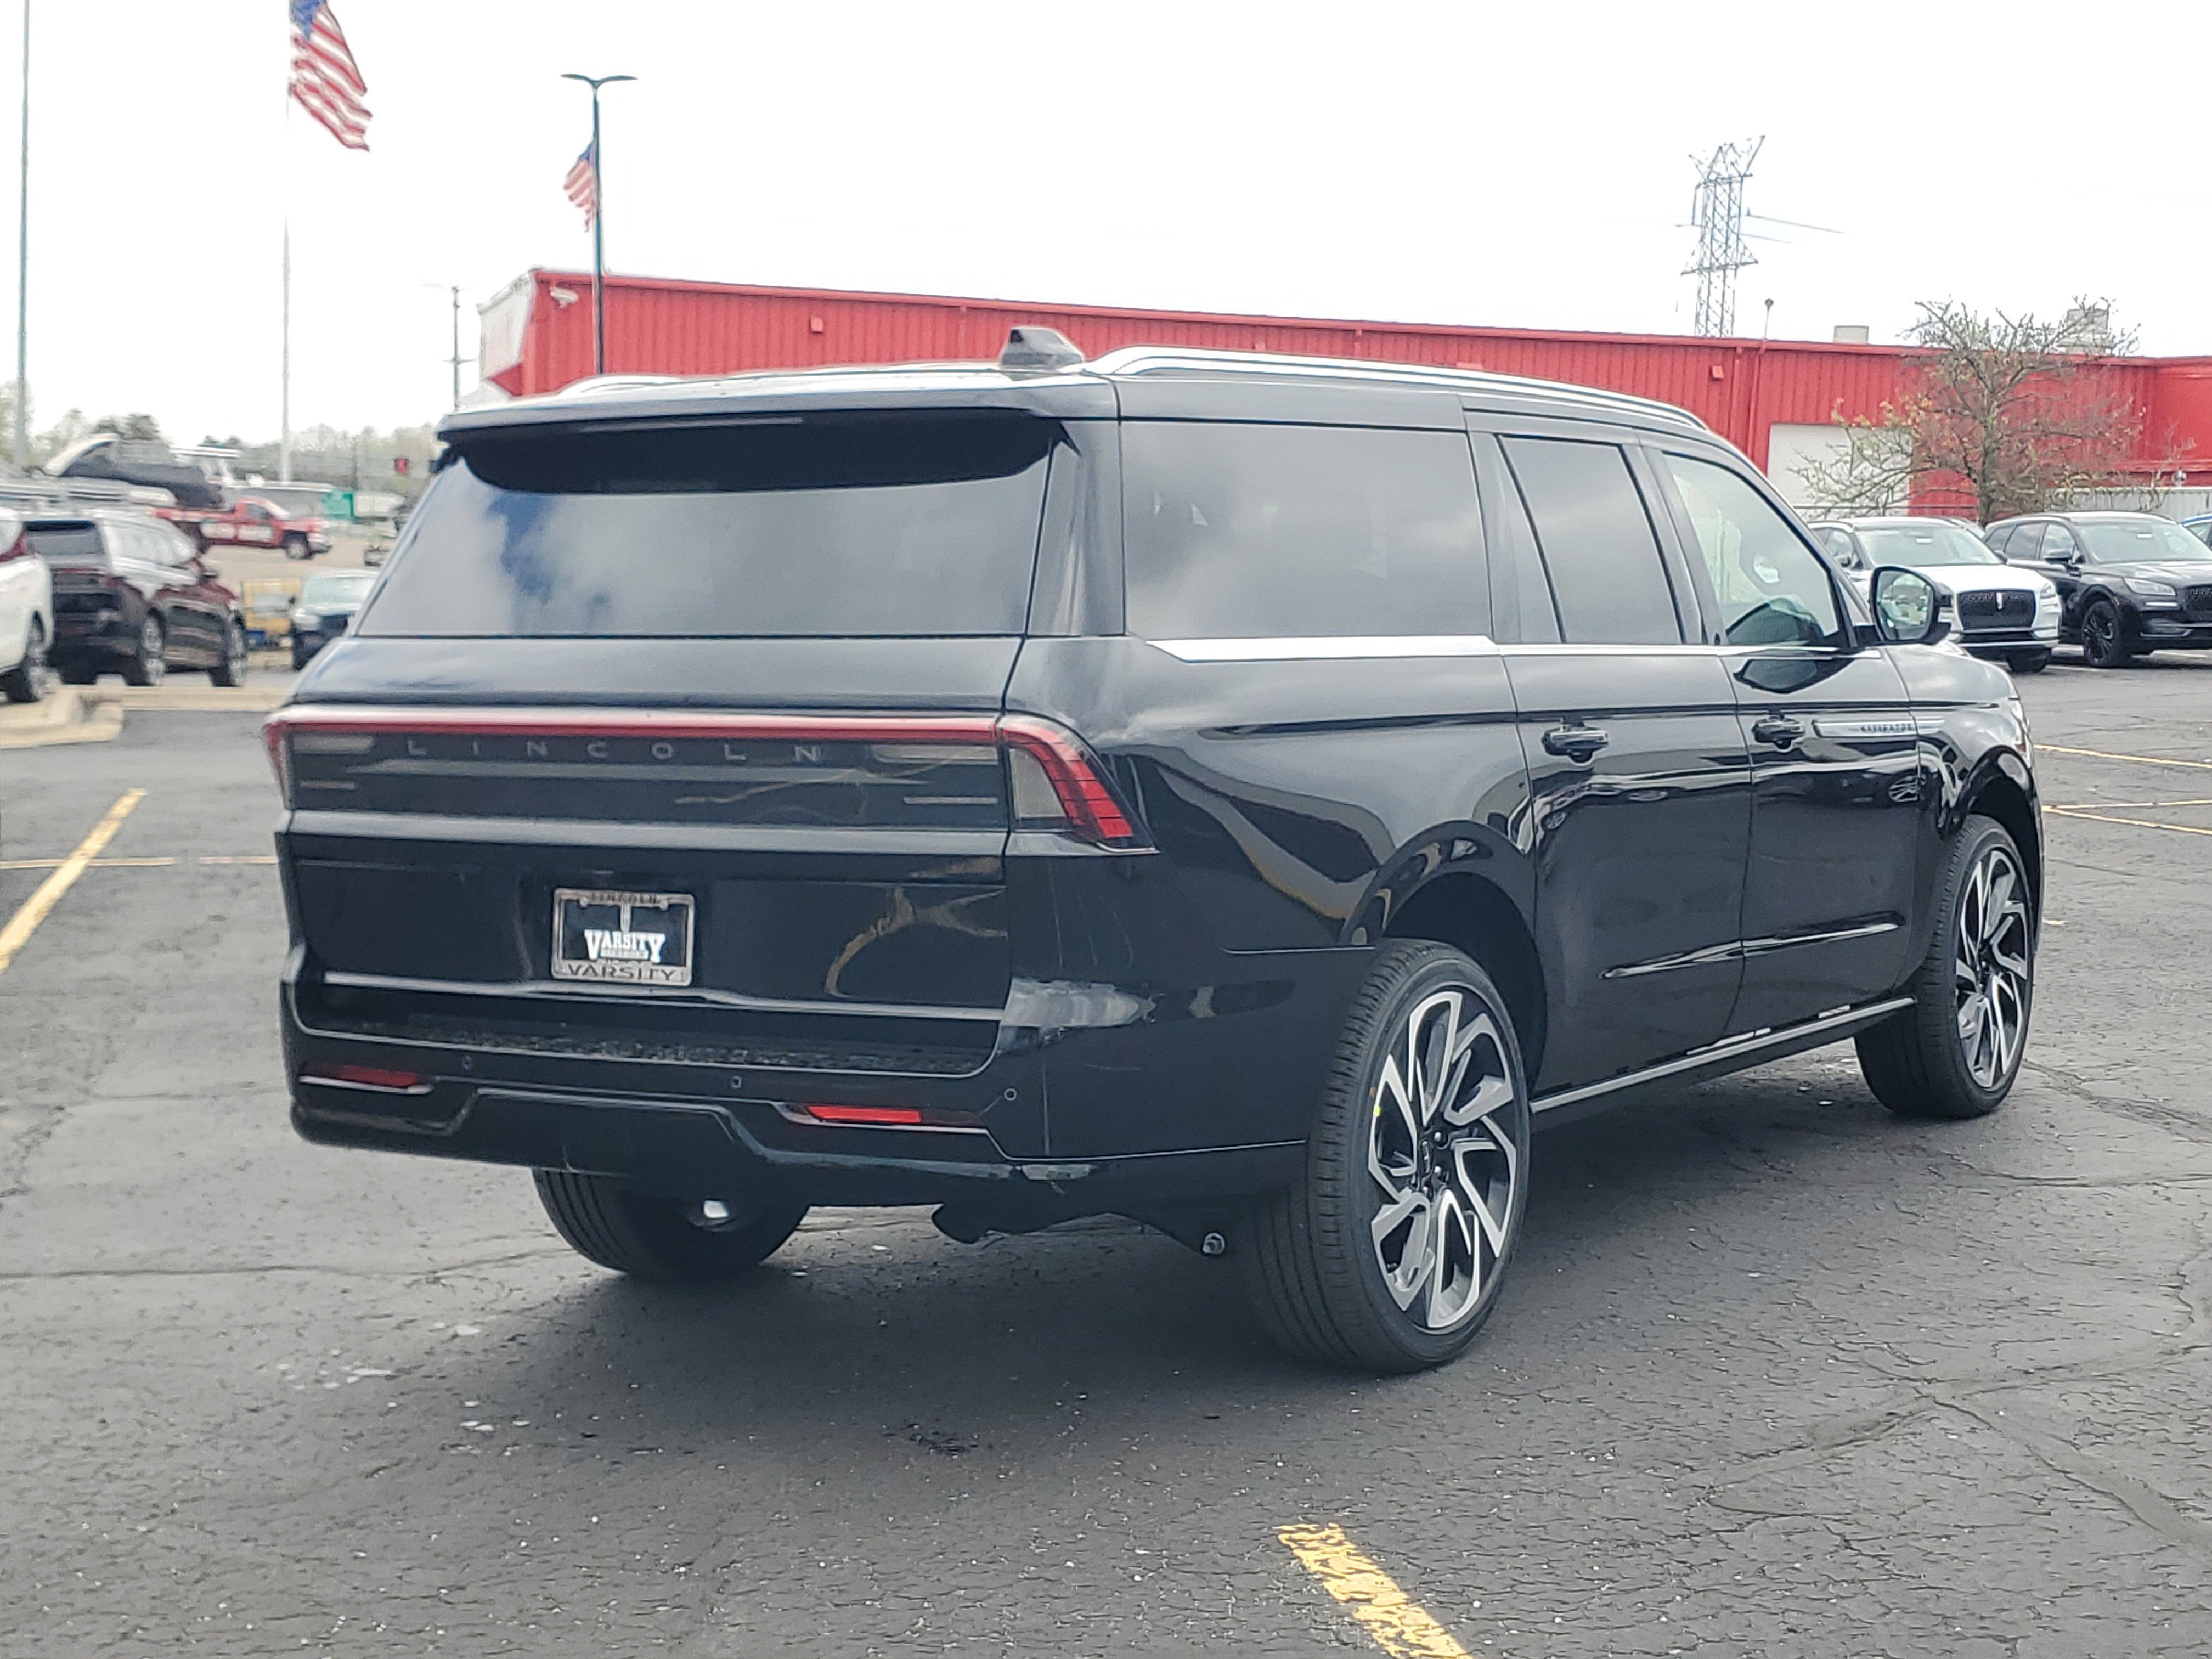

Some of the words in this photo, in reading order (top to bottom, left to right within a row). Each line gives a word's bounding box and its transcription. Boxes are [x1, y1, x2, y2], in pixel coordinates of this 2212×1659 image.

[407, 739, 818, 763] LINCOLN
[584, 929, 665, 963] VARSITY
[567, 963, 676, 981] VARSITY
